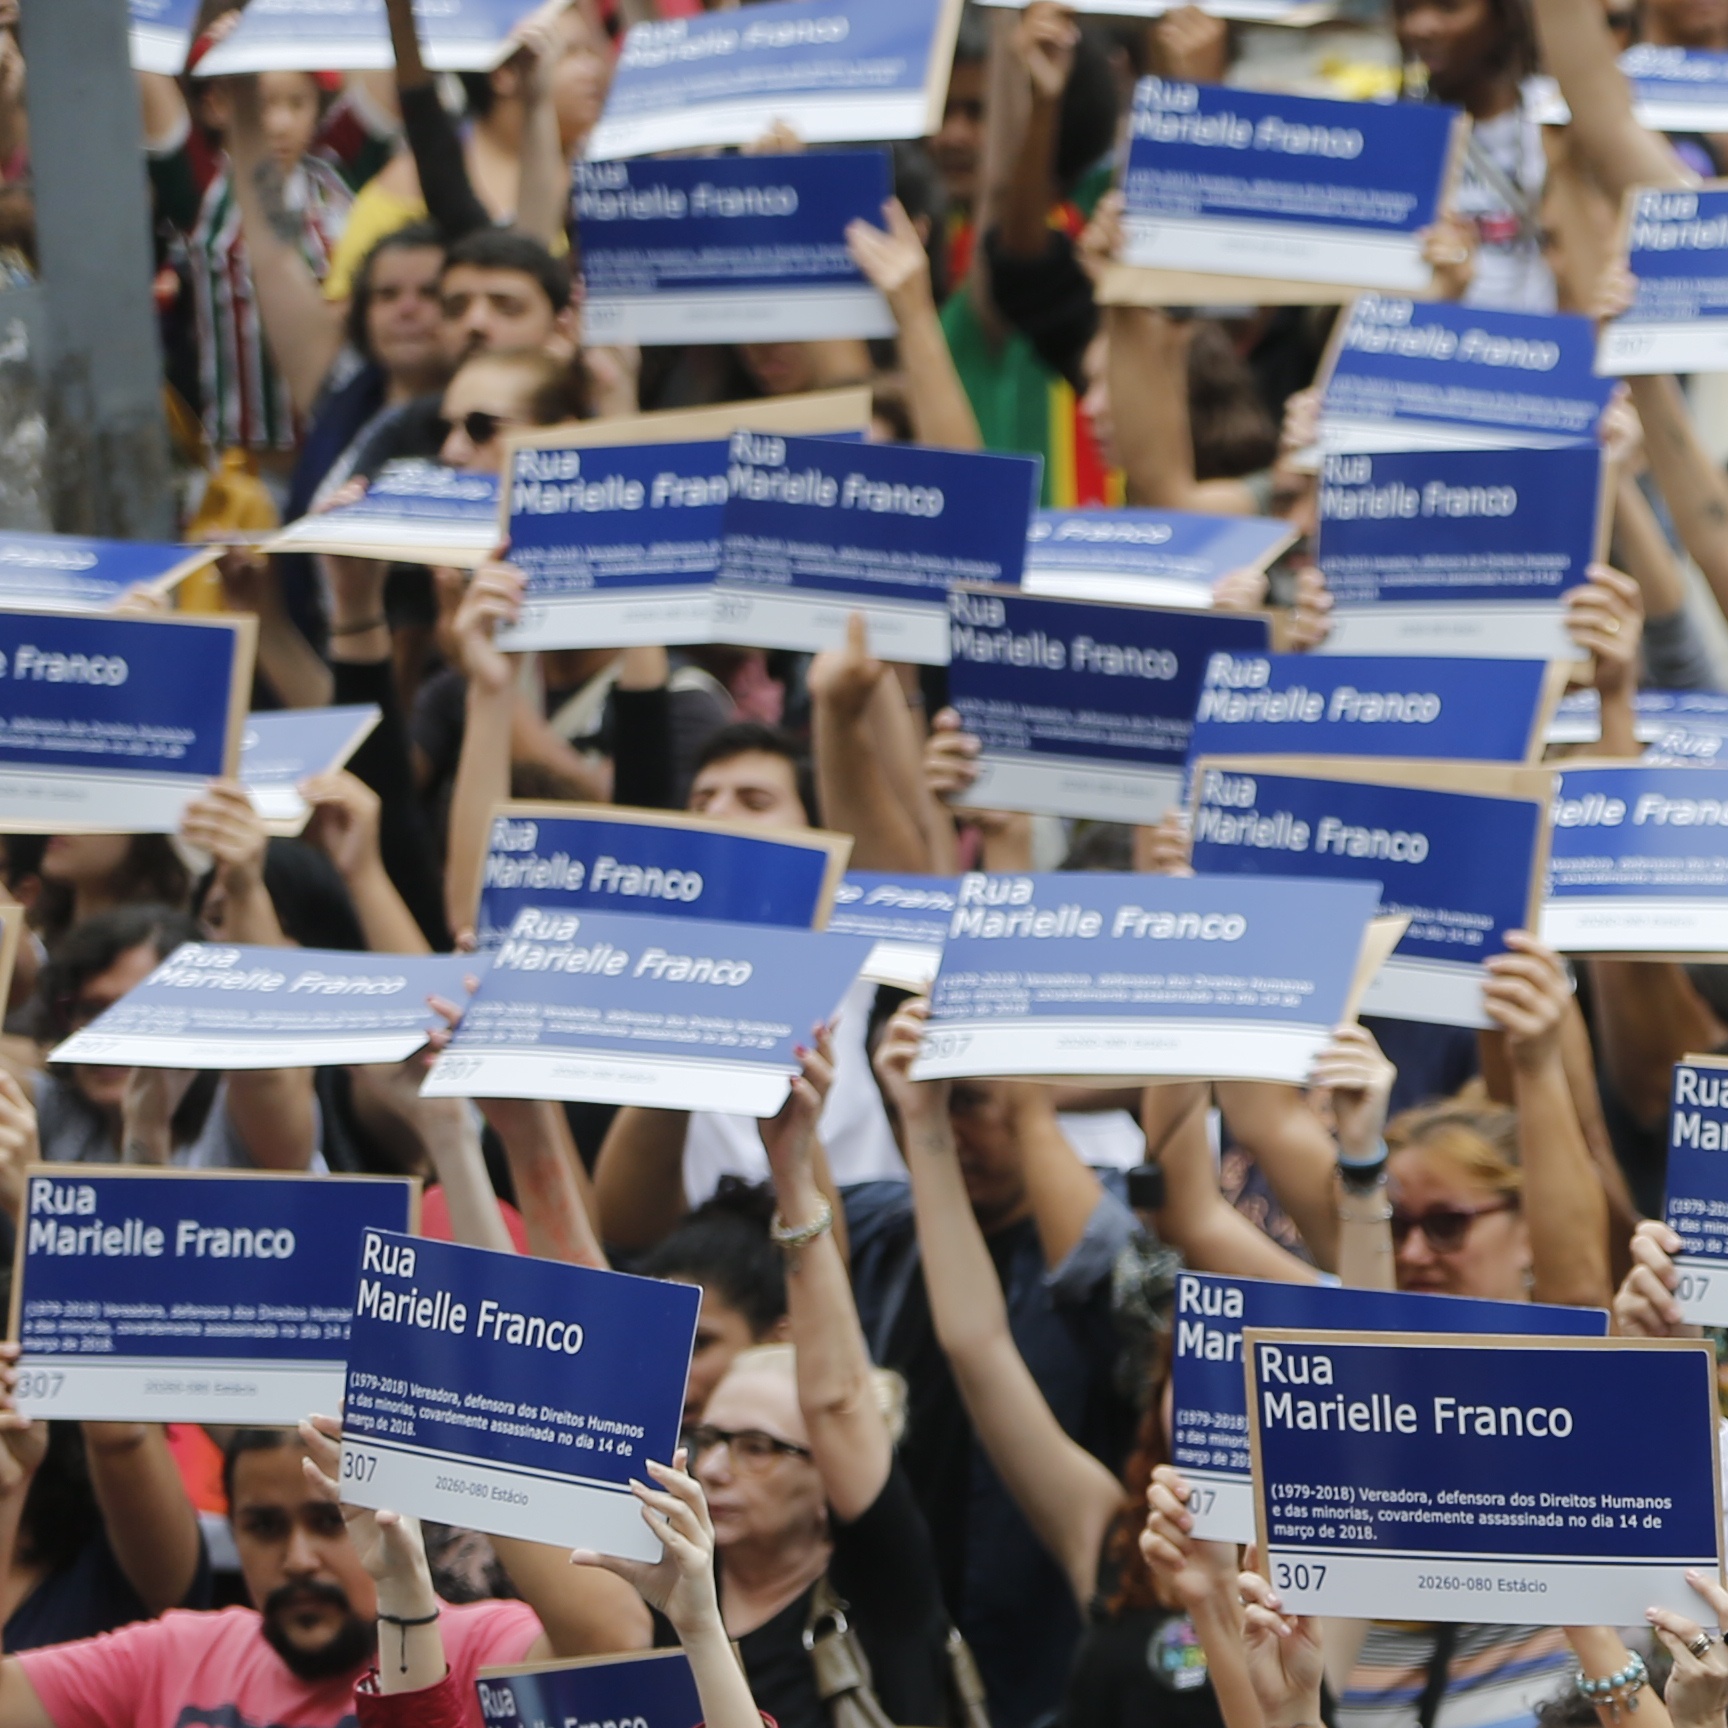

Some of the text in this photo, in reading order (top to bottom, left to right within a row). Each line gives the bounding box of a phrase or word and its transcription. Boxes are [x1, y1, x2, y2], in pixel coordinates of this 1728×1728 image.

[1205, 652, 1271, 688] Rua
[1197, 686, 1442, 724] Marielle Franco
[363, 1234, 415, 1277] Rua
[357, 1279, 583, 1354] Marielle Franco
[1261, 1344, 1333, 1385] Rua
[1264, 1392, 1572, 1437] Marielle Franco
[343, 1452, 378, 1483] 307
[1278, 1563, 1326, 1590] 307
[478, 1683, 517, 1719] Rua
